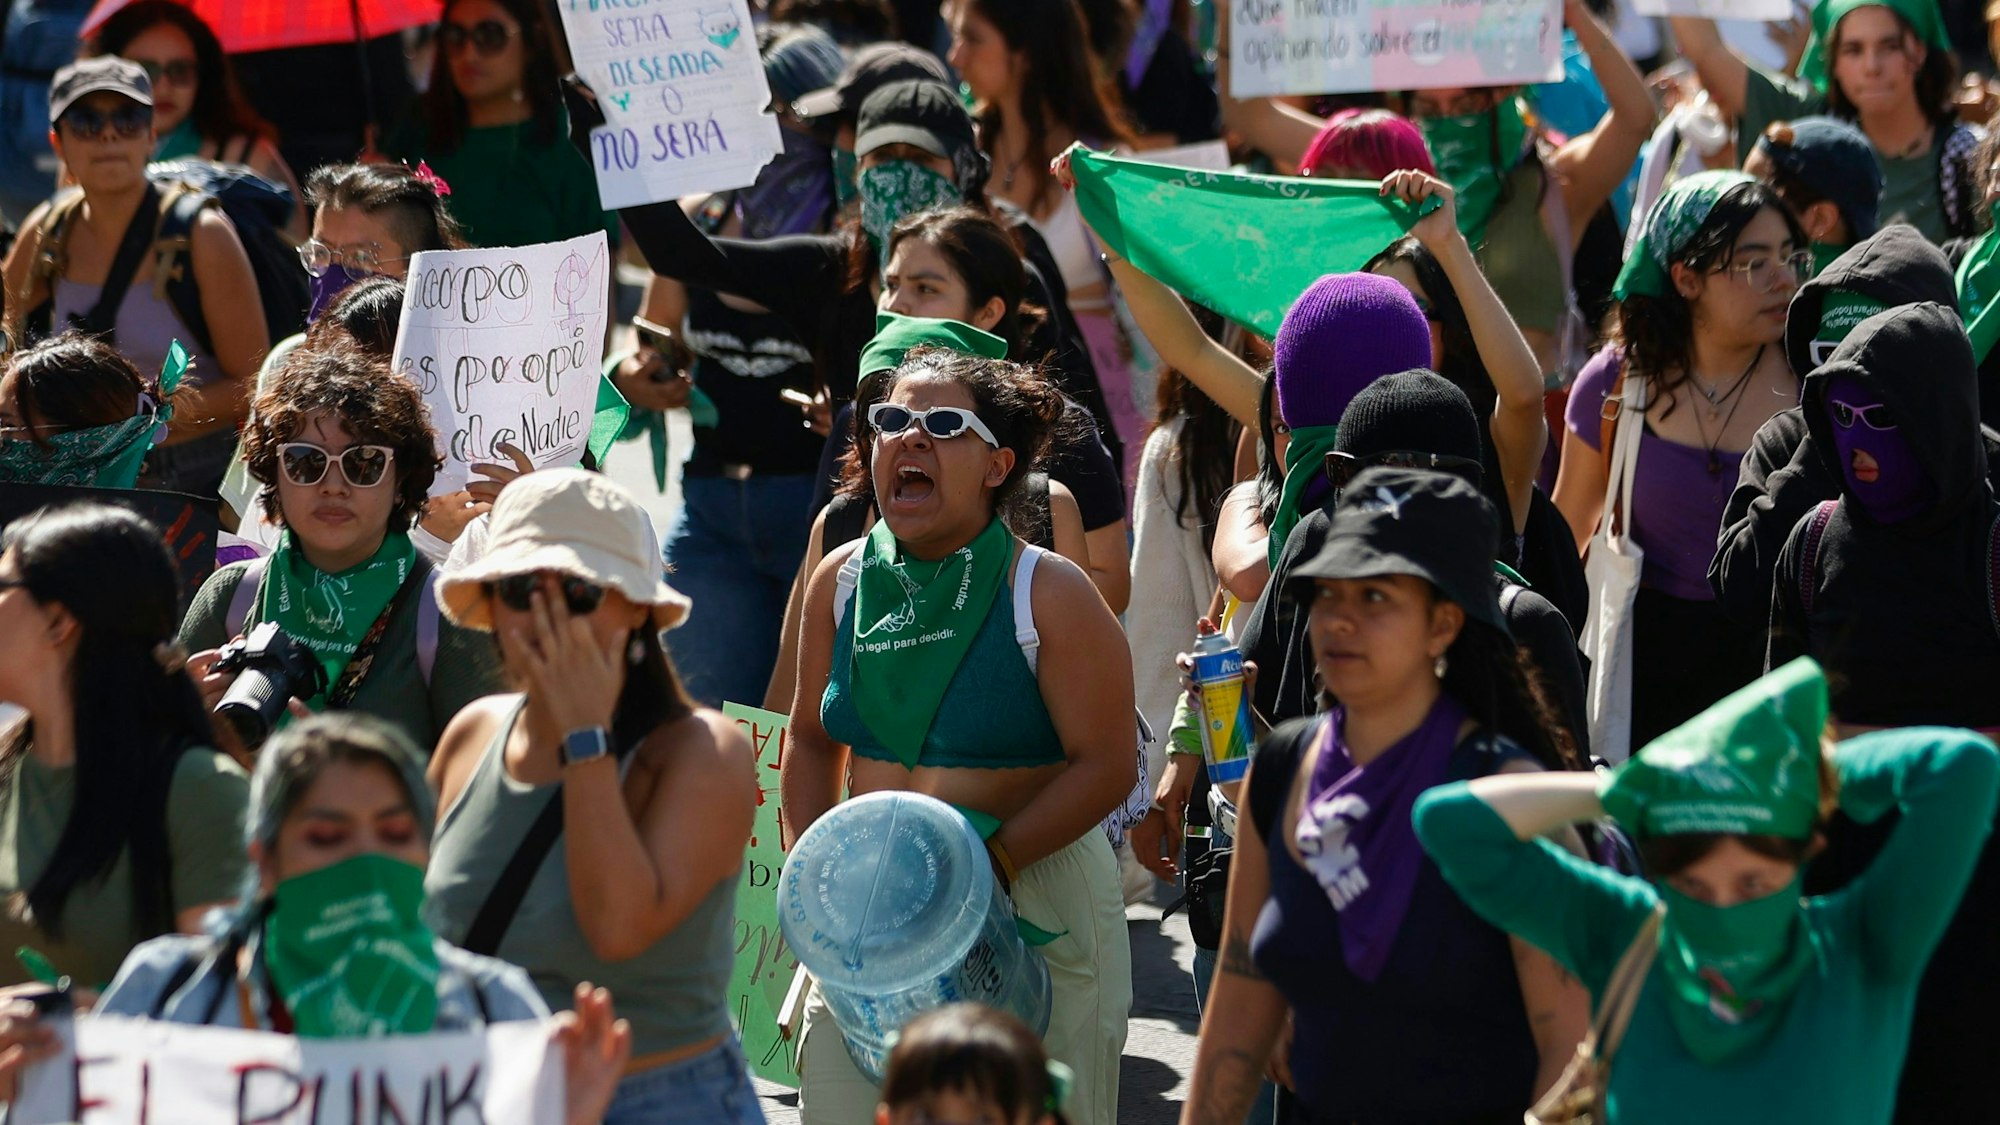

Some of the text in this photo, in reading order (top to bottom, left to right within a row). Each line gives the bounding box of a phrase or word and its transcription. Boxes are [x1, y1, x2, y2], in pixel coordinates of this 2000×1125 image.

[609, 51, 723, 86] DESEADA
[662, 87, 683, 115] O
[652, 112, 728, 162] SERÁ
[865, 639, 891, 653] legal
[893, 637, 917, 651] para
[919, 628, 957, 644] decidir.
